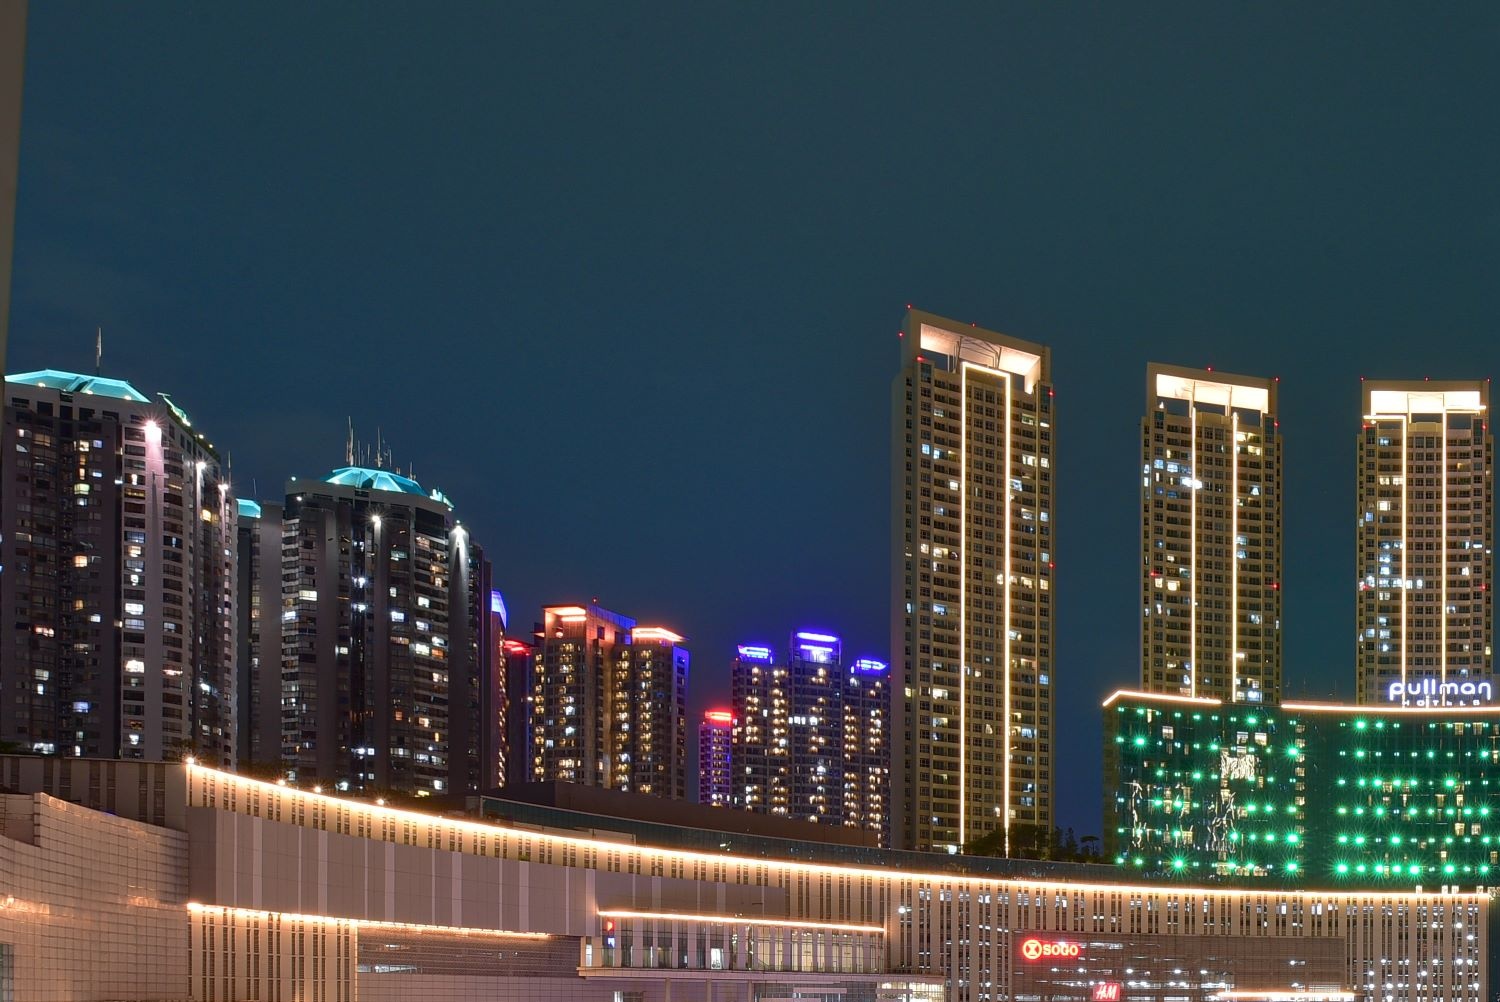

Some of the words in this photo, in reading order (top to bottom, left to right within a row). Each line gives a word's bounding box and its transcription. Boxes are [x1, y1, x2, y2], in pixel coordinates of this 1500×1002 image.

[1389, 678, 1492, 701] pullman
[1043, 943, 1079, 956] SOGO
[1095, 984, 1118, 1000] H&M
